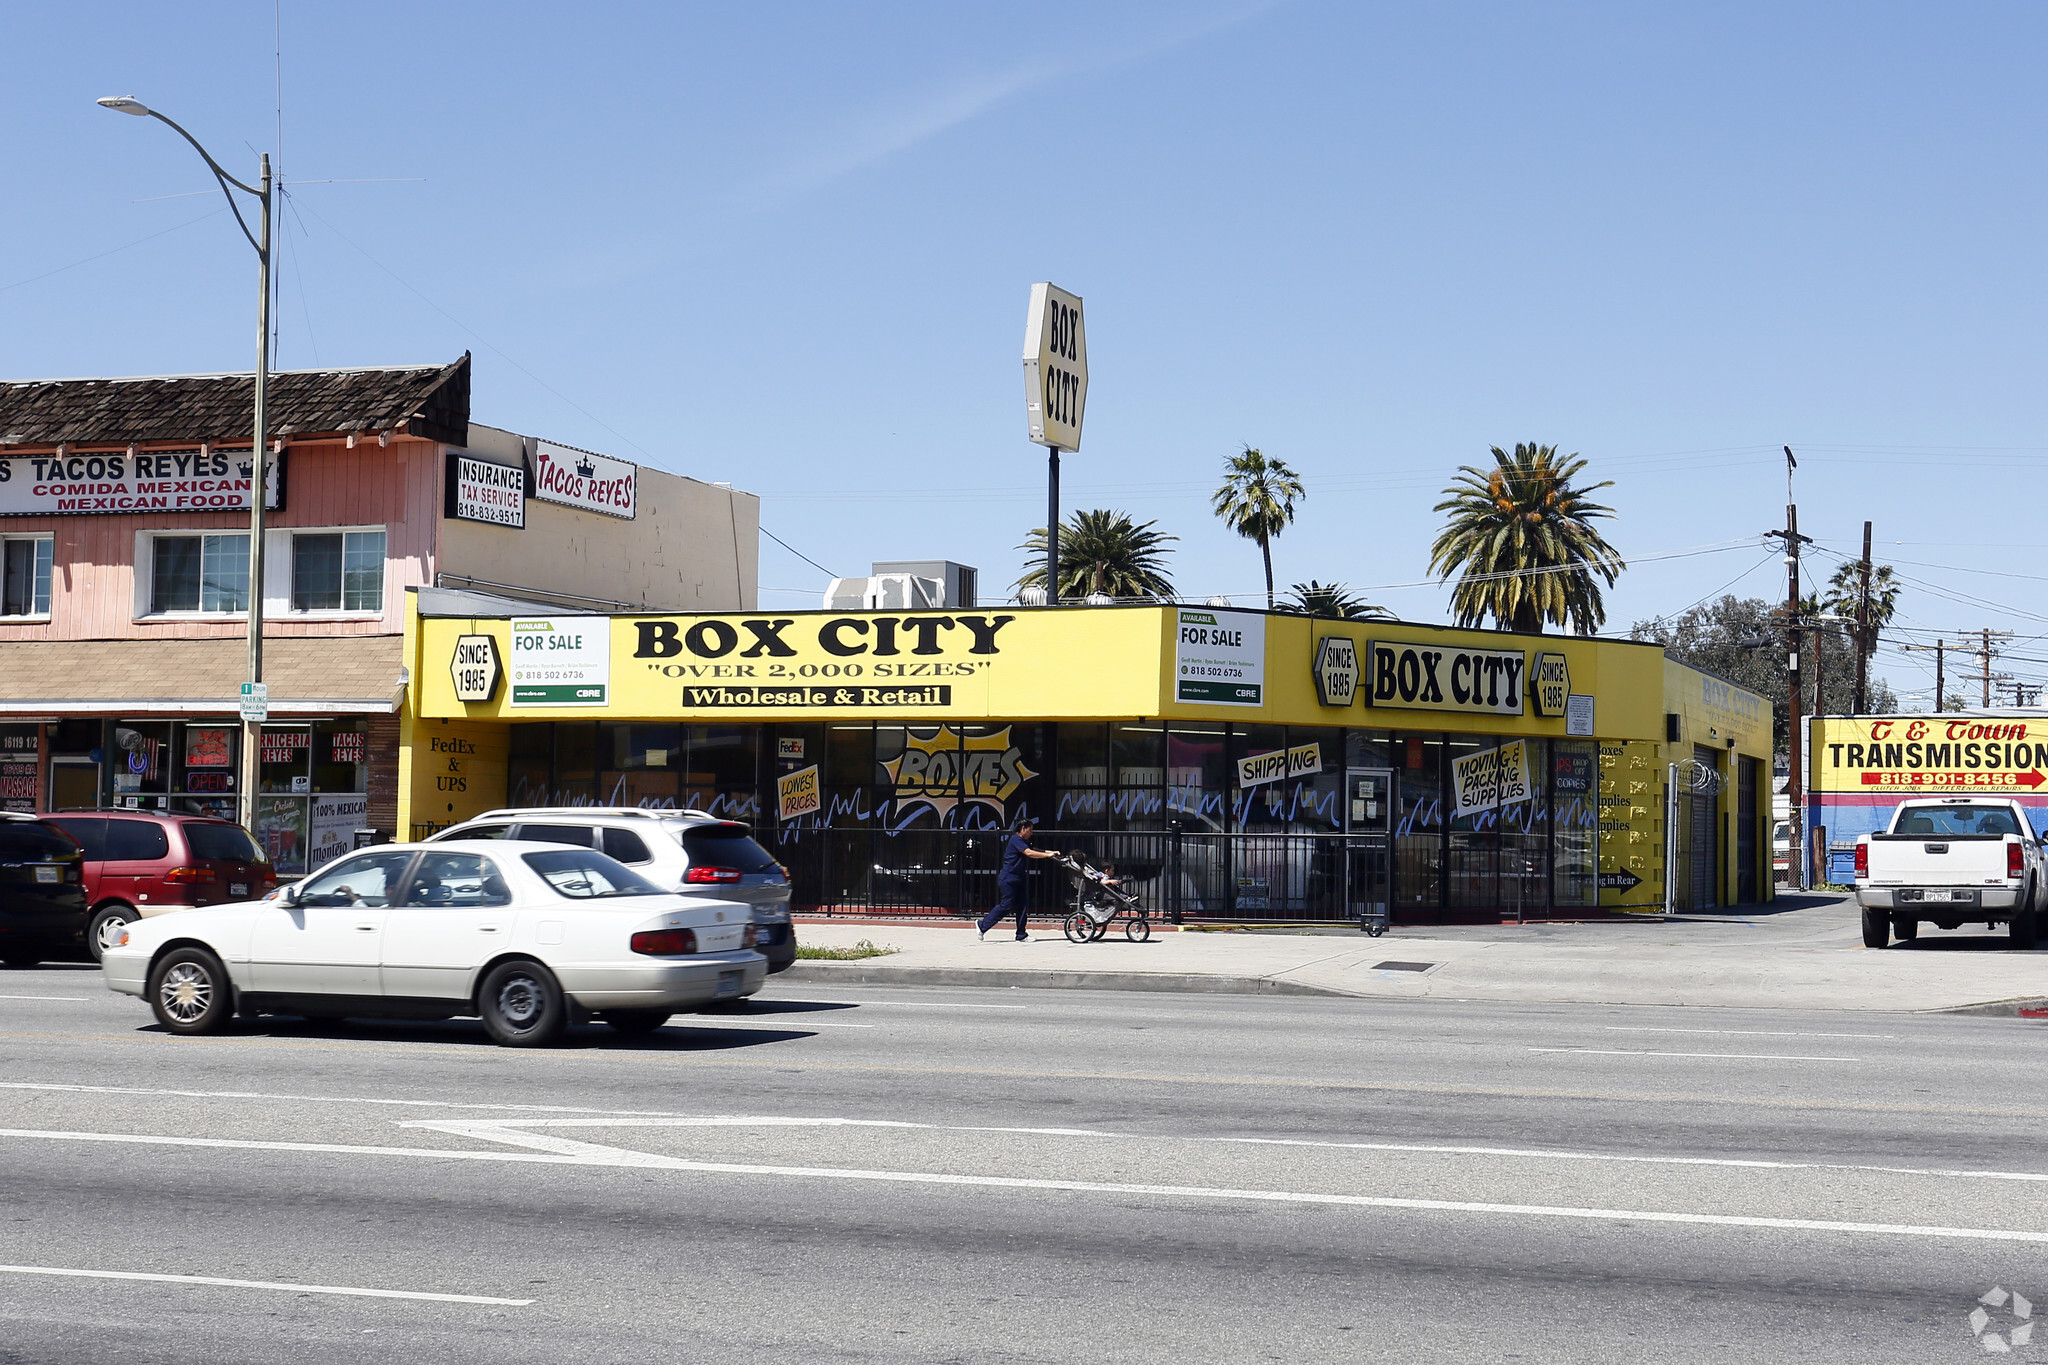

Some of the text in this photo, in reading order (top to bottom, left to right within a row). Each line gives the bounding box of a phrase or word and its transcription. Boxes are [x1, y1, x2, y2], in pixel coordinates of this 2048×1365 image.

[1050, 299, 1079, 362] BOX
[1046, 364, 1079, 428] CITY
[31, 456, 125, 481] TACOS
[135, 453, 229, 479] REYES
[459, 460, 522, 491] INSURANCE
[33, 479, 270, 497] COMIDA MEXICAN
[538, 454, 632, 509] TACOS REYES
[57, 494, 243, 511] MEXICAN FOOD
[462, 484, 519, 509] TAX SERVICE
[458, 502, 521, 525] 818-832-9517
[515, 622, 548, 630] AVAILABLE
[1182, 613, 1212, 623] AVAILABLE
[515, 635, 582, 651] FOR SALE
[633, 615, 1016, 659] BOX CITY
[1181, 627, 1242, 648] FOR SALE
[459, 644, 488, 665] SINCE
[1327, 646, 1352, 669] SINCE
[458, 669, 486, 692] 1985
[526, 671, 584, 680] 818 502 6736
[648, 660, 992, 682] "OVER 2,000 SIZES"
[1190, 666, 1243, 678] 818 502 6736
[1373, 648, 1524, 708] BOX CITY
[1541, 661, 1564, 683] SINCE
[576, 689, 601, 698] CBRE
[1235, 689, 1257, 698] CBRE
[1327, 672, 1350, 697] 1985
[242, 695, 266, 704] PARKING
[689, 686, 942, 706] Wholesale & Retail
[1541, 686, 1563, 709] 1985
[1702, 677, 1731, 713] BOX
[1732, 689, 1761, 723] CITY
[333, 733, 364, 747] TACOS
[1906, 720, 1930, 741] &
[1944, 719, 2030, 741] Town
[4, 736, 38, 749] 16119 1/2
[430, 737, 476, 754] FedEx
[780, 740, 802, 753] FedEx
[1600, 746, 1624, 756] oxes
[262, 749, 293, 762] REYES
[332, 748, 364, 762] REYES
[448, 757, 460, 772] &
[1243, 749, 1317, 780] SHIPPING
[1457, 750, 1509, 779] MOVING
[1572, 758, 1589, 767] DROP
[1828, 743, 2048, 769] TRANSMISSION
[190, 774, 227, 790] OPEN
[436, 776, 467, 792] UPS
[781, 771, 815, 797] LOWEST
[896, 746, 1022, 801] BOXES
[1462, 768, 1519, 794] PACKING
[1556, 777, 1587, 790] COPIES
[1880, 773, 2017, 785] 818-901-8456
[1, 776, 38, 799] MASSAGE
[1461, 783, 1525, 808] SUPPLIES
[784, 792, 817, 815] PRICES
[1607, 874, 1616, 885] in
[1616, 874, 1636, 885] Rear
